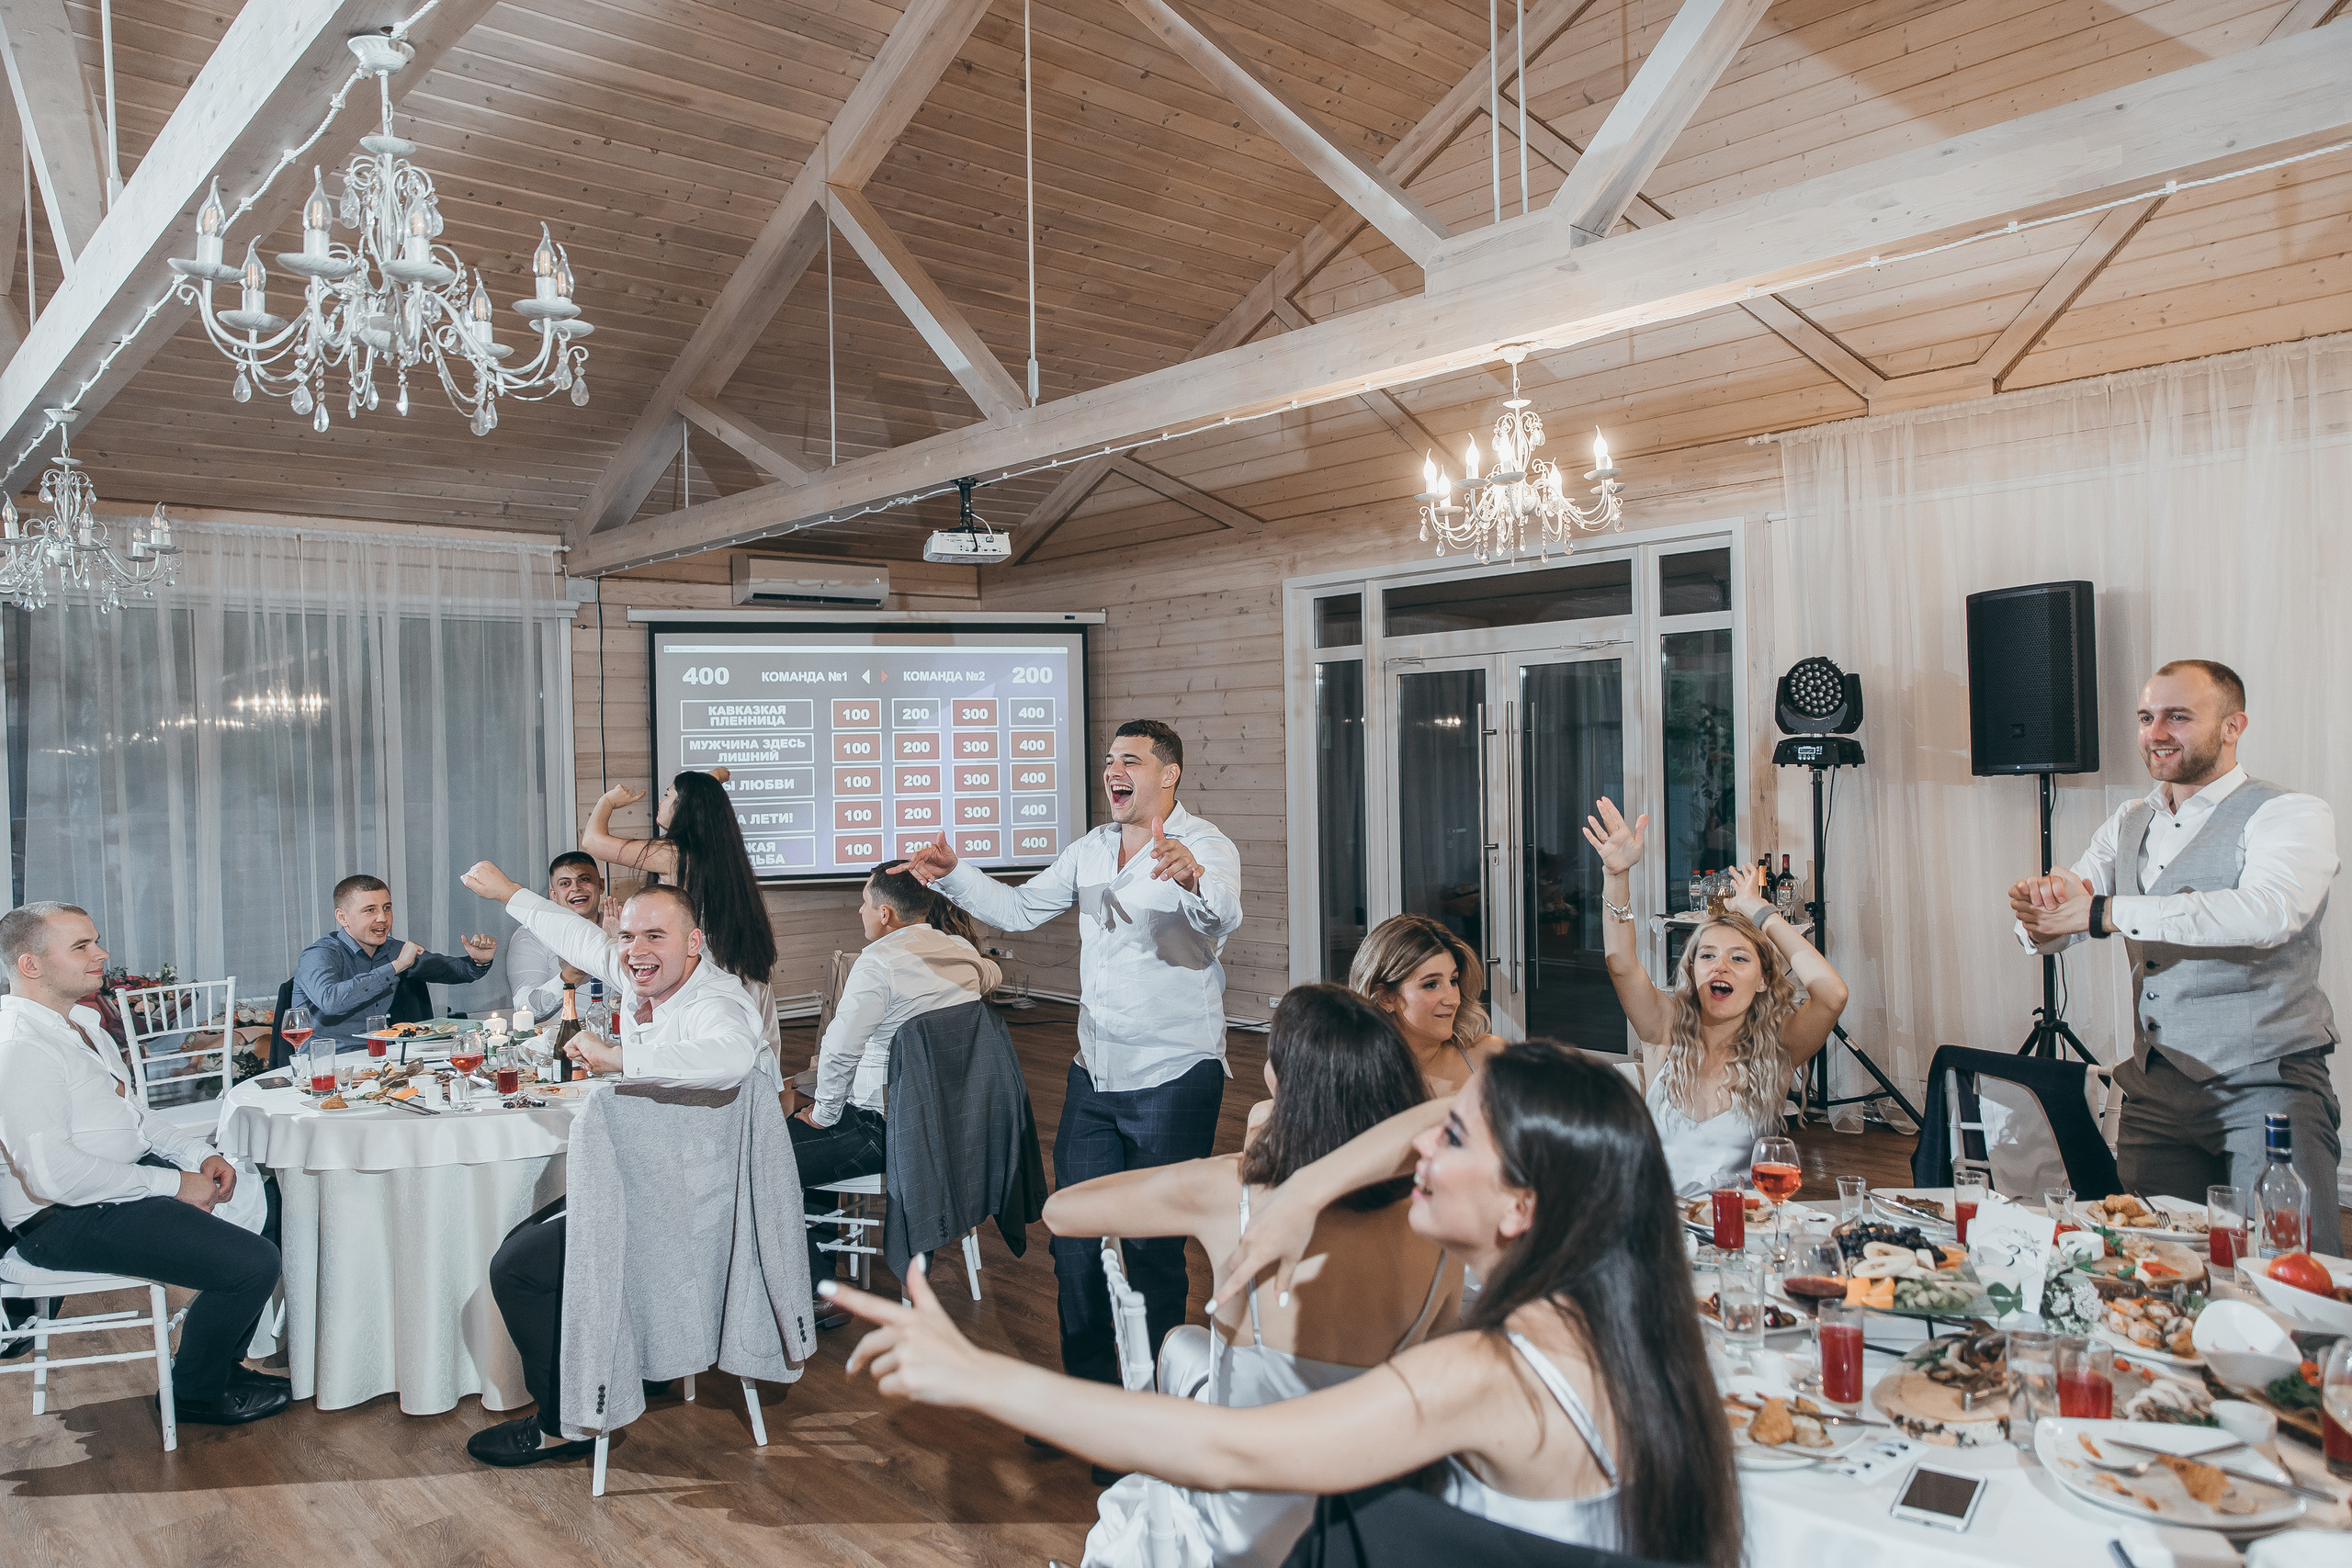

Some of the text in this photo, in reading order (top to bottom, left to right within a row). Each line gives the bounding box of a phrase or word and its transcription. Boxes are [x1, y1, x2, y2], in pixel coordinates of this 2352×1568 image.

[682, 667, 729, 685] 400
[762, 671, 848, 683] КОМАНДА №1
[903, 671, 985, 683] КОМАНДА №2
[1012, 666, 1053, 684] 200
[707, 705, 786, 716] КАВКАЗКАЯ
[842, 708, 870, 721] 100
[901, 707, 930, 720] 200
[961, 707, 989, 720] 300
[1018, 706, 1046, 719] 400
[710, 716, 786, 727] ПЛЕННИЦА
[689, 738, 807, 751] МУЖЧИНА ЗДЕСЬ
[842, 742, 871, 754] 100
[902, 740, 931, 753] 200
[962, 740, 989, 752] 300
[1019, 739, 1046, 751] 400
[718, 750, 779, 762] ЛИШНИЙ
[739, 778, 795, 791] ЛЮБВИ
[843, 775, 872, 788] 100
[903, 774, 932, 786] 200
[963, 773, 990, 785] 300
[1020, 772, 1046, 784] 400
[843, 808, 873, 822] 100
[904, 807, 932, 819] 200
[964, 806, 991, 818] 300
[1020, 804, 1047, 817] 400
[750, 812, 794, 825] ЛЕТИ!
[744, 841, 776, 852] ЖАЯ
[844, 842, 873, 856] 100
[964, 839, 992, 852] 300
[1021, 836, 1049, 849] 400
[748, 853, 786, 866] ДЬБА
